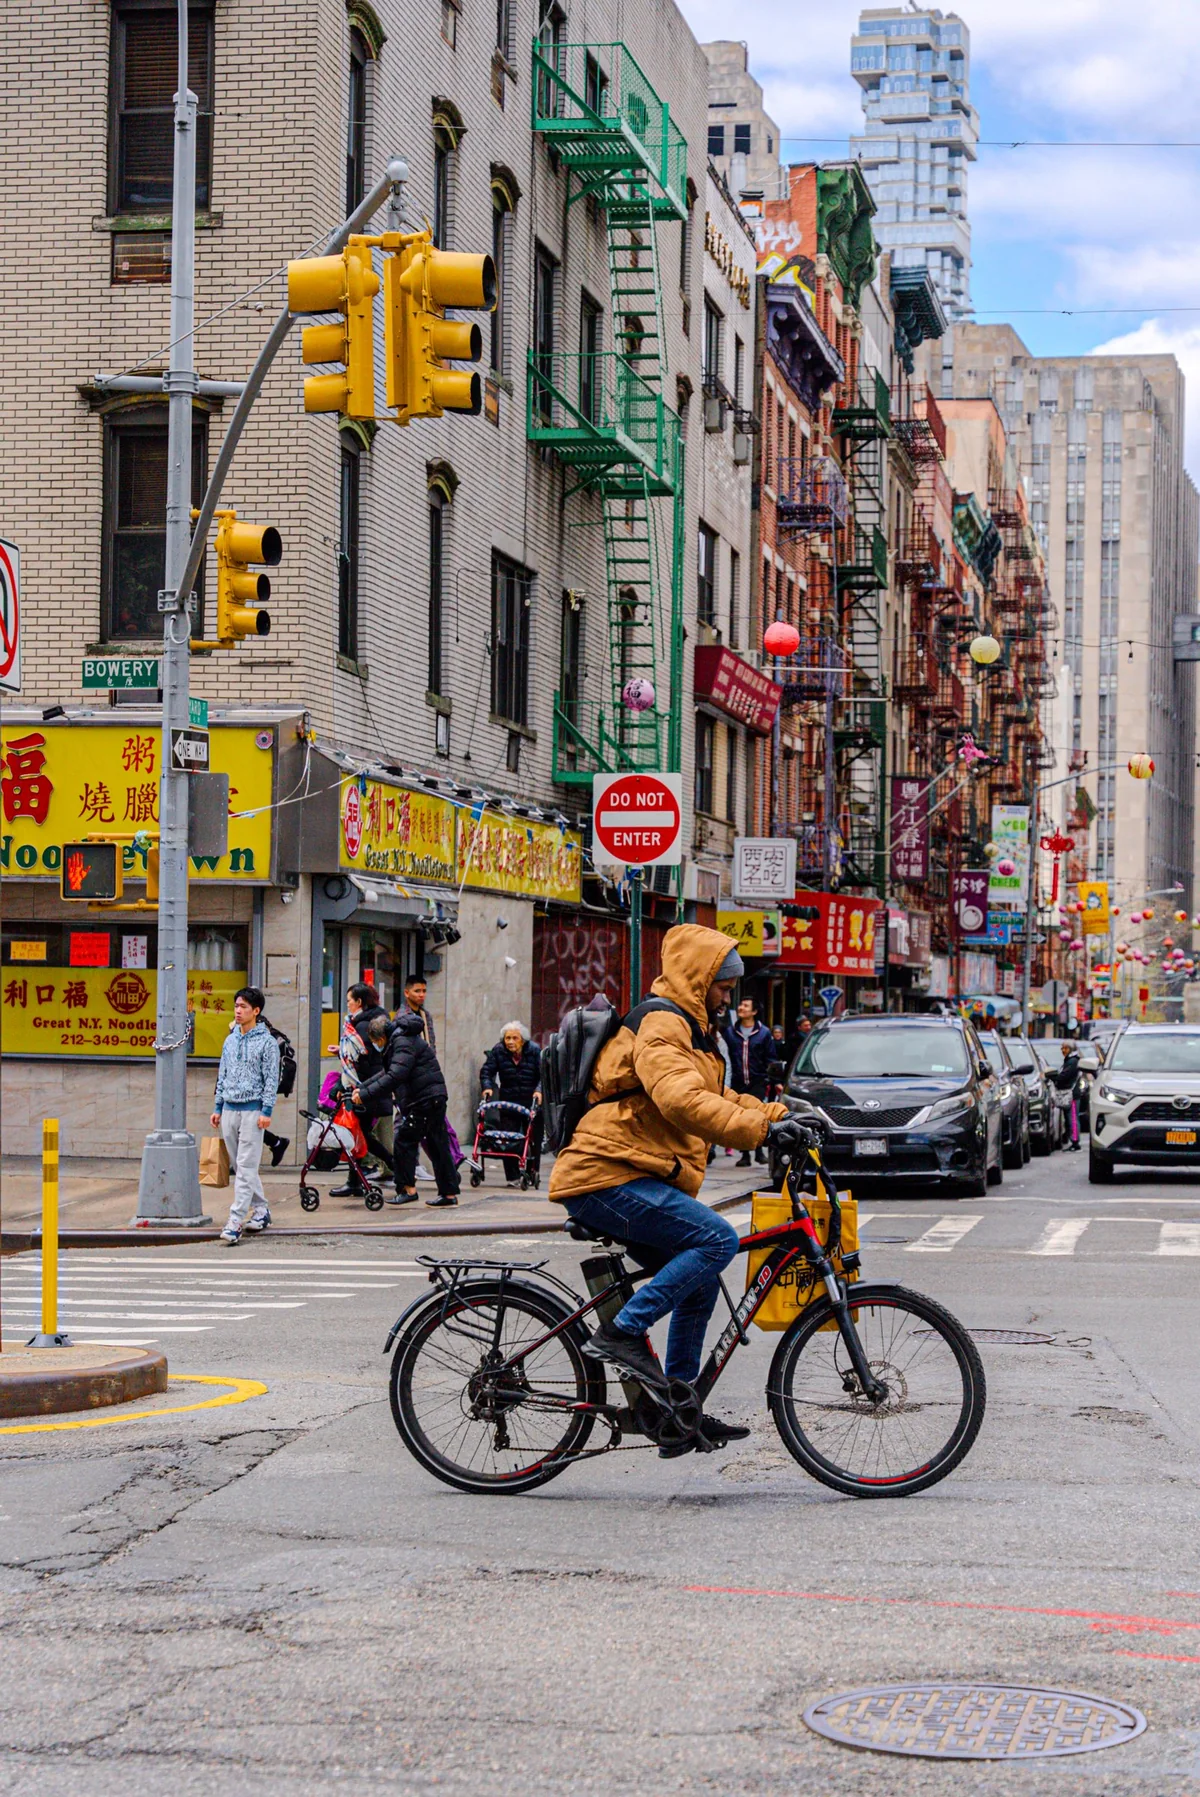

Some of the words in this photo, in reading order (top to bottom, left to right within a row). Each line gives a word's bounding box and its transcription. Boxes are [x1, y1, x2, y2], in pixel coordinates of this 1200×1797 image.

[84, 661, 155, 677] BOWERY
[178, 742, 190, 757] ONE
[194, 743, 206, 757] WAY
[610, 792, 631, 807] DO
[636, 792, 665, 807] NOT
[613, 832, 661, 846] ENTER
[4, 979, 89, 1008] 利口福
[32, 1017, 72, 1028] Great
[78, 1018, 103, 1029] N.Y.
